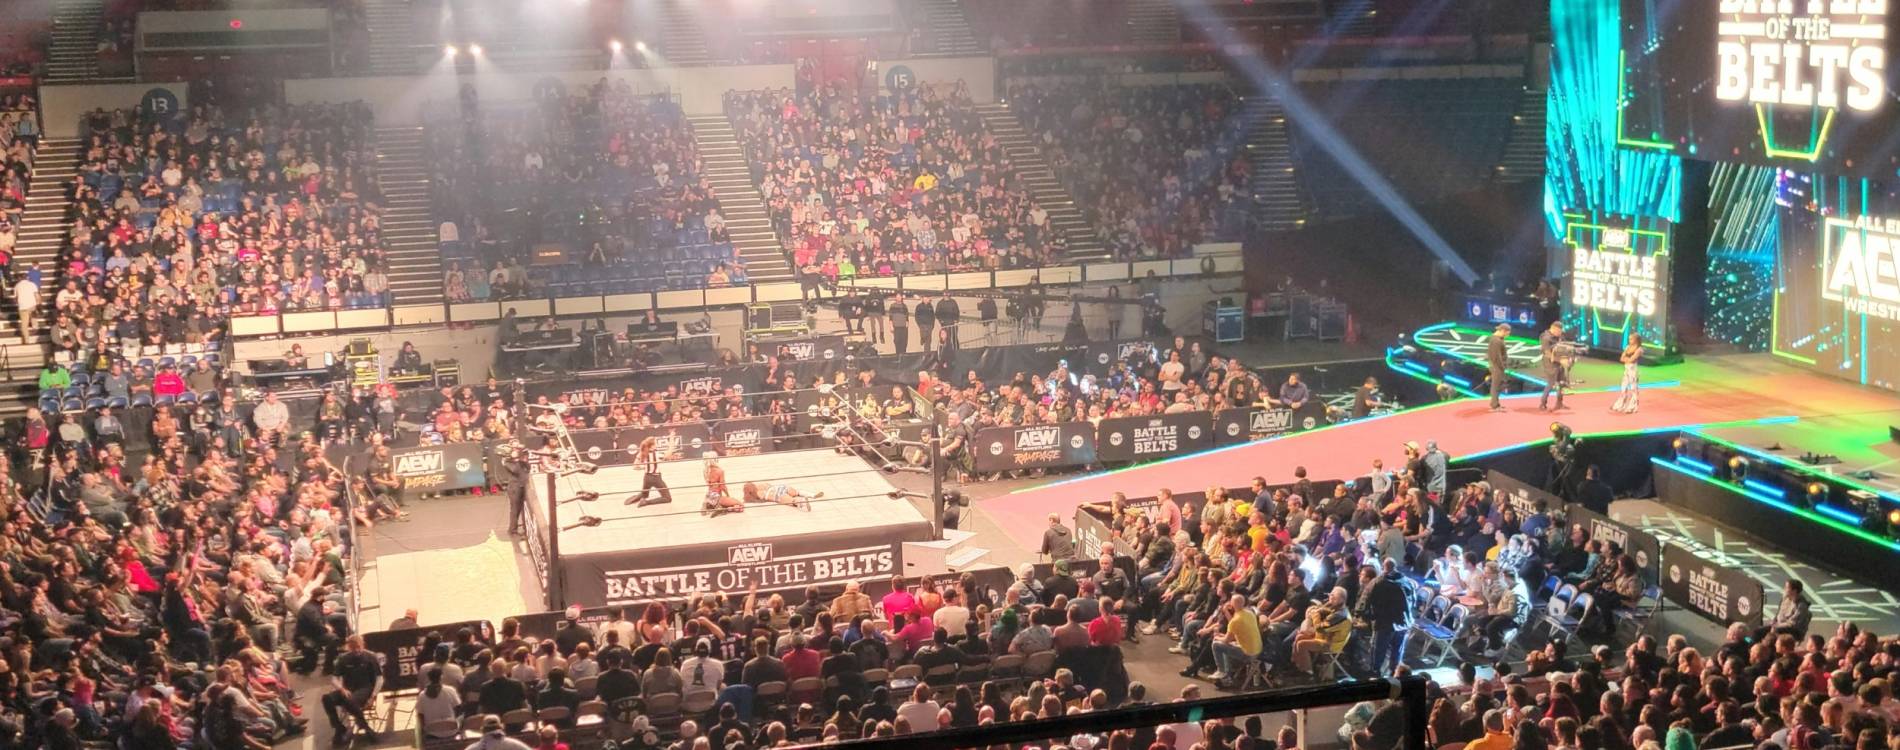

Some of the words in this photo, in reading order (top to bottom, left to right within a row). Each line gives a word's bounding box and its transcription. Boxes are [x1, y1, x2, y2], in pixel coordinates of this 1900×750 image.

[1765, 17, 1790, 39] OF
[1792, 18, 1831, 41] THE
[894, 74, 908, 88] 15
[1716, 41, 1885, 111] BELTS
[152, 98, 168, 113] 13
[1855, 215, 1884, 232] ALL
[1575, 248, 1656, 280] BATTLE
[1828, 230, 1900, 304] AE
[1573, 279, 1656, 316] BELTS
[1252, 411, 1290, 429] AEW
[1017, 429, 1058, 448] AEW
[1134, 425, 1177, 438] BATTLE
[1134, 440, 1178, 454] BELTS
[397, 453, 440, 473] AEW
[1013, 450, 1061, 464] RAMPAGE
[731, 546, 769, 563] AEW
[605, 571, 711, 599] BATTLE
[717, 568, 749, 590] OF
[755, 562, 807, 587] THE
[813, 551, 893, 580] BELTS
[1689, 569, 1728, 599] BATTLE
[1689, 588, 1728, 620] BELTS
